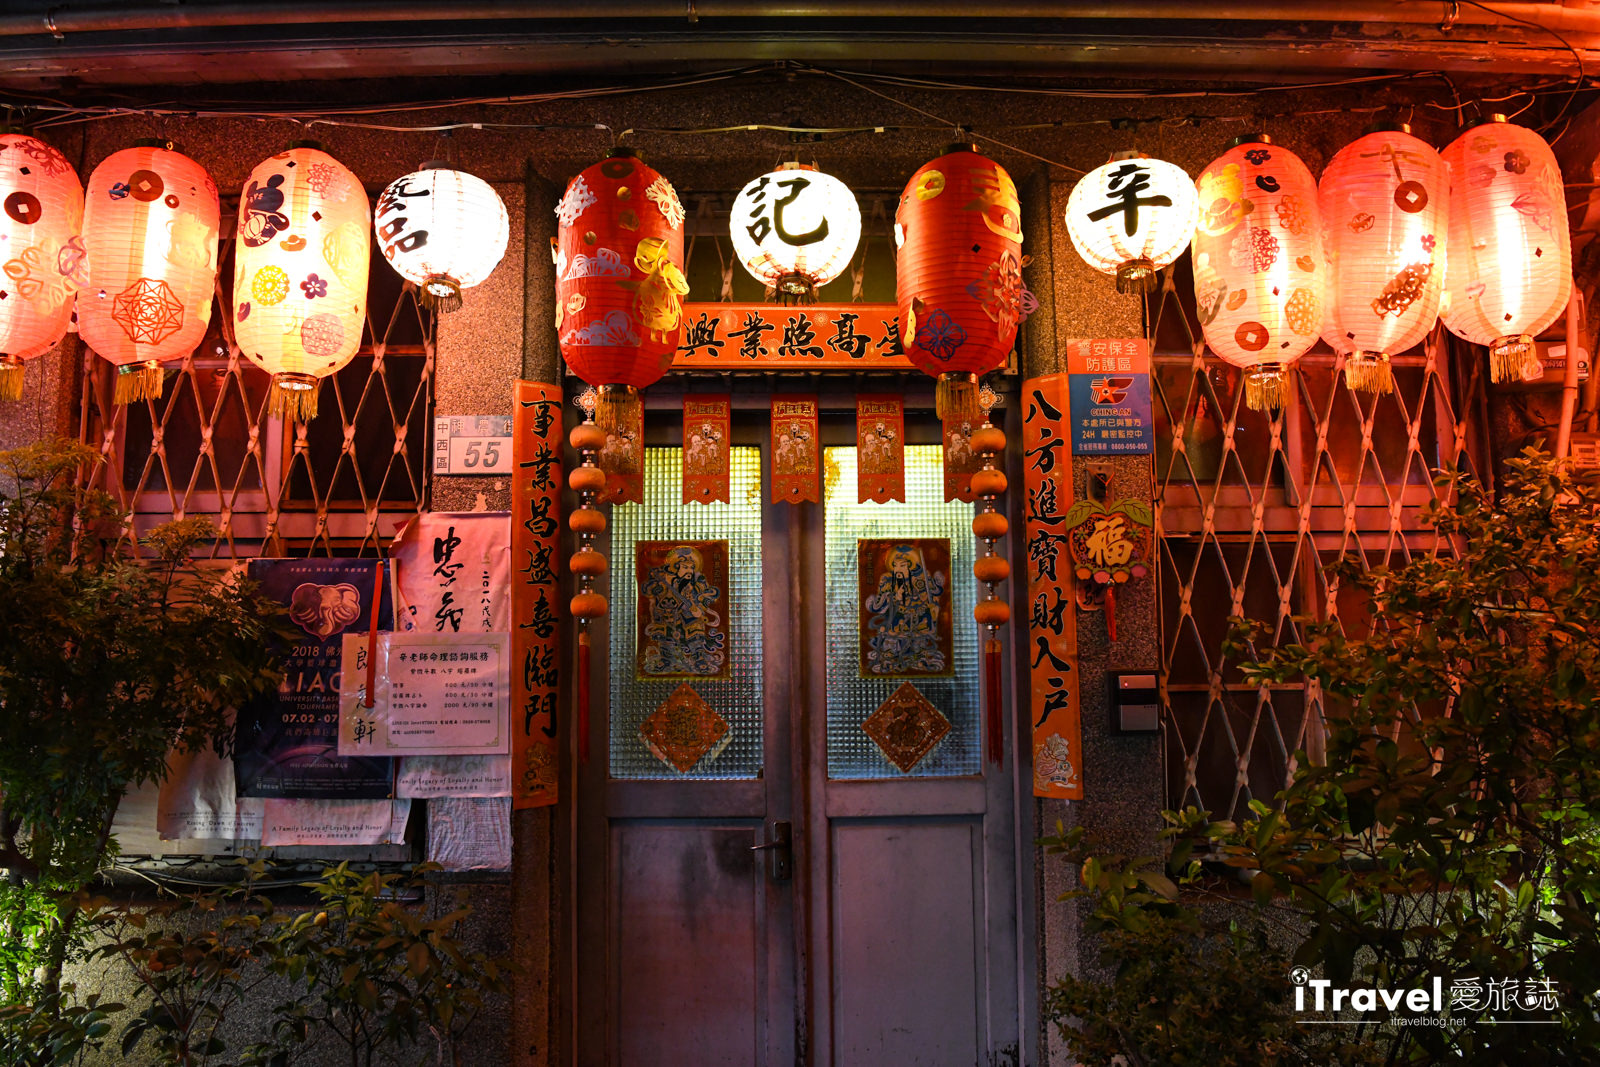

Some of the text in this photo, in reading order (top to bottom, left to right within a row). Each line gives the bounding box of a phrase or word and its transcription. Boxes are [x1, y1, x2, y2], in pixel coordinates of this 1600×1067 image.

[746, 177, 829, 246] 記
[1087, 164, 1172, 237] 辛
[1086, 357, 1131, 371] 防護區
[437, 422, 448, 469] 中西區
[464, 441, 501, 467] 55
[1082, 430, 1095, 439] 24H
[520, 390, 561, 738] 事業昌盛喜臨門
[1025, 390, 1070, 728] 八方進寶財入戶
[1086, 517, 1133, 566] 福
[292, 646, 319, 657] 2018
[282, 714, 315, 723] 07.02
